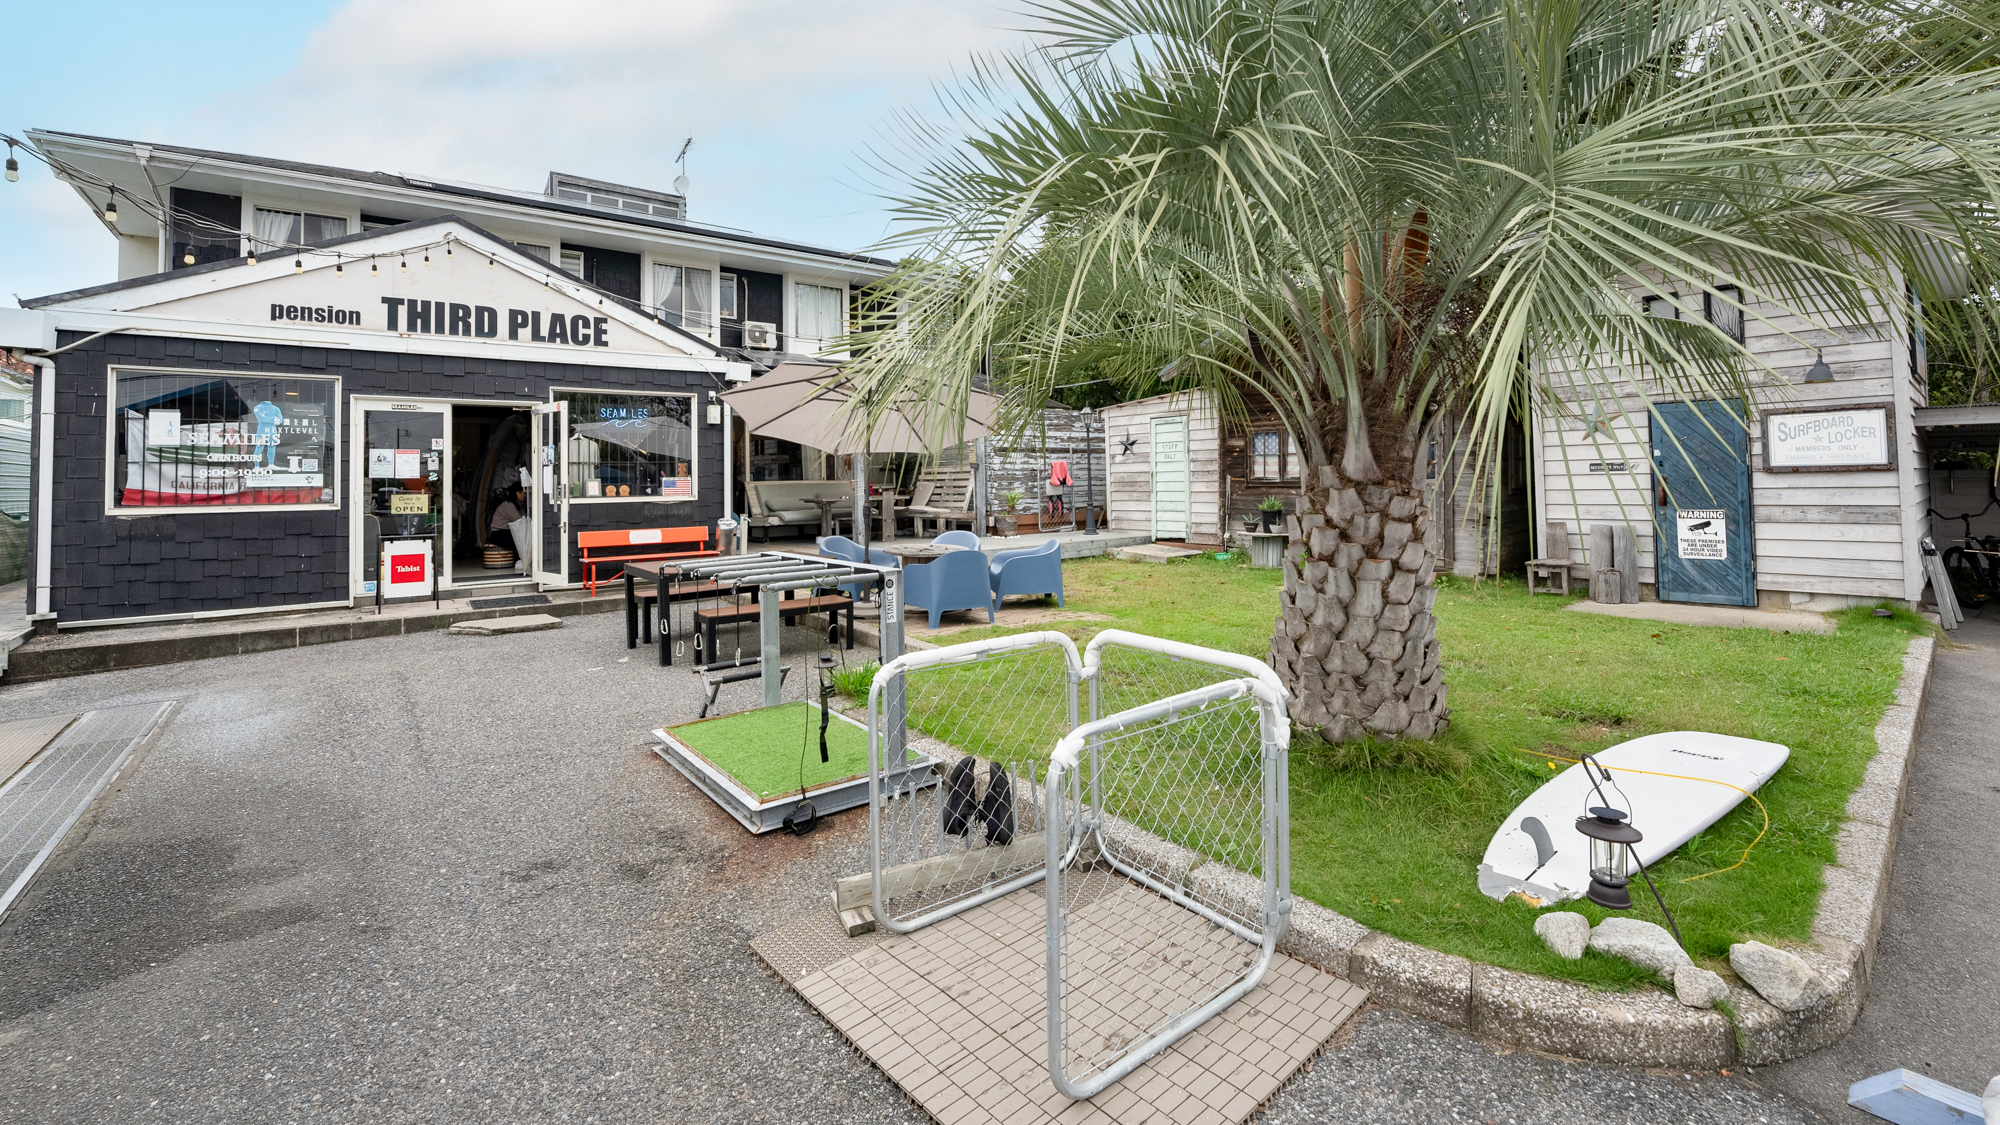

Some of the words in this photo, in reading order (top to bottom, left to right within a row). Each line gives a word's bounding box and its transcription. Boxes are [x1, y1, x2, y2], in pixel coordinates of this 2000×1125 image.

[270, 303, 361, 326] pension
[381, 296, 498, 338] THIRD
[508, 308, 609, 347] PLACE
[600, 407, 649, 419] SEAMLES
[264, 427, 319, 435] NEXTLEVEL
[1777, 416, 1854, 443] SURFBOARD
[1828, 426, 1877, 444] LOCKER
[187, 432, 281, 447] SEAMILES
[206, 454, 231, 463] OPEN
[232, 453, 263, 463] HOURS
[1679, 511, 1724, 519] WARNING
[886, 591, 895, 621] STANCE
